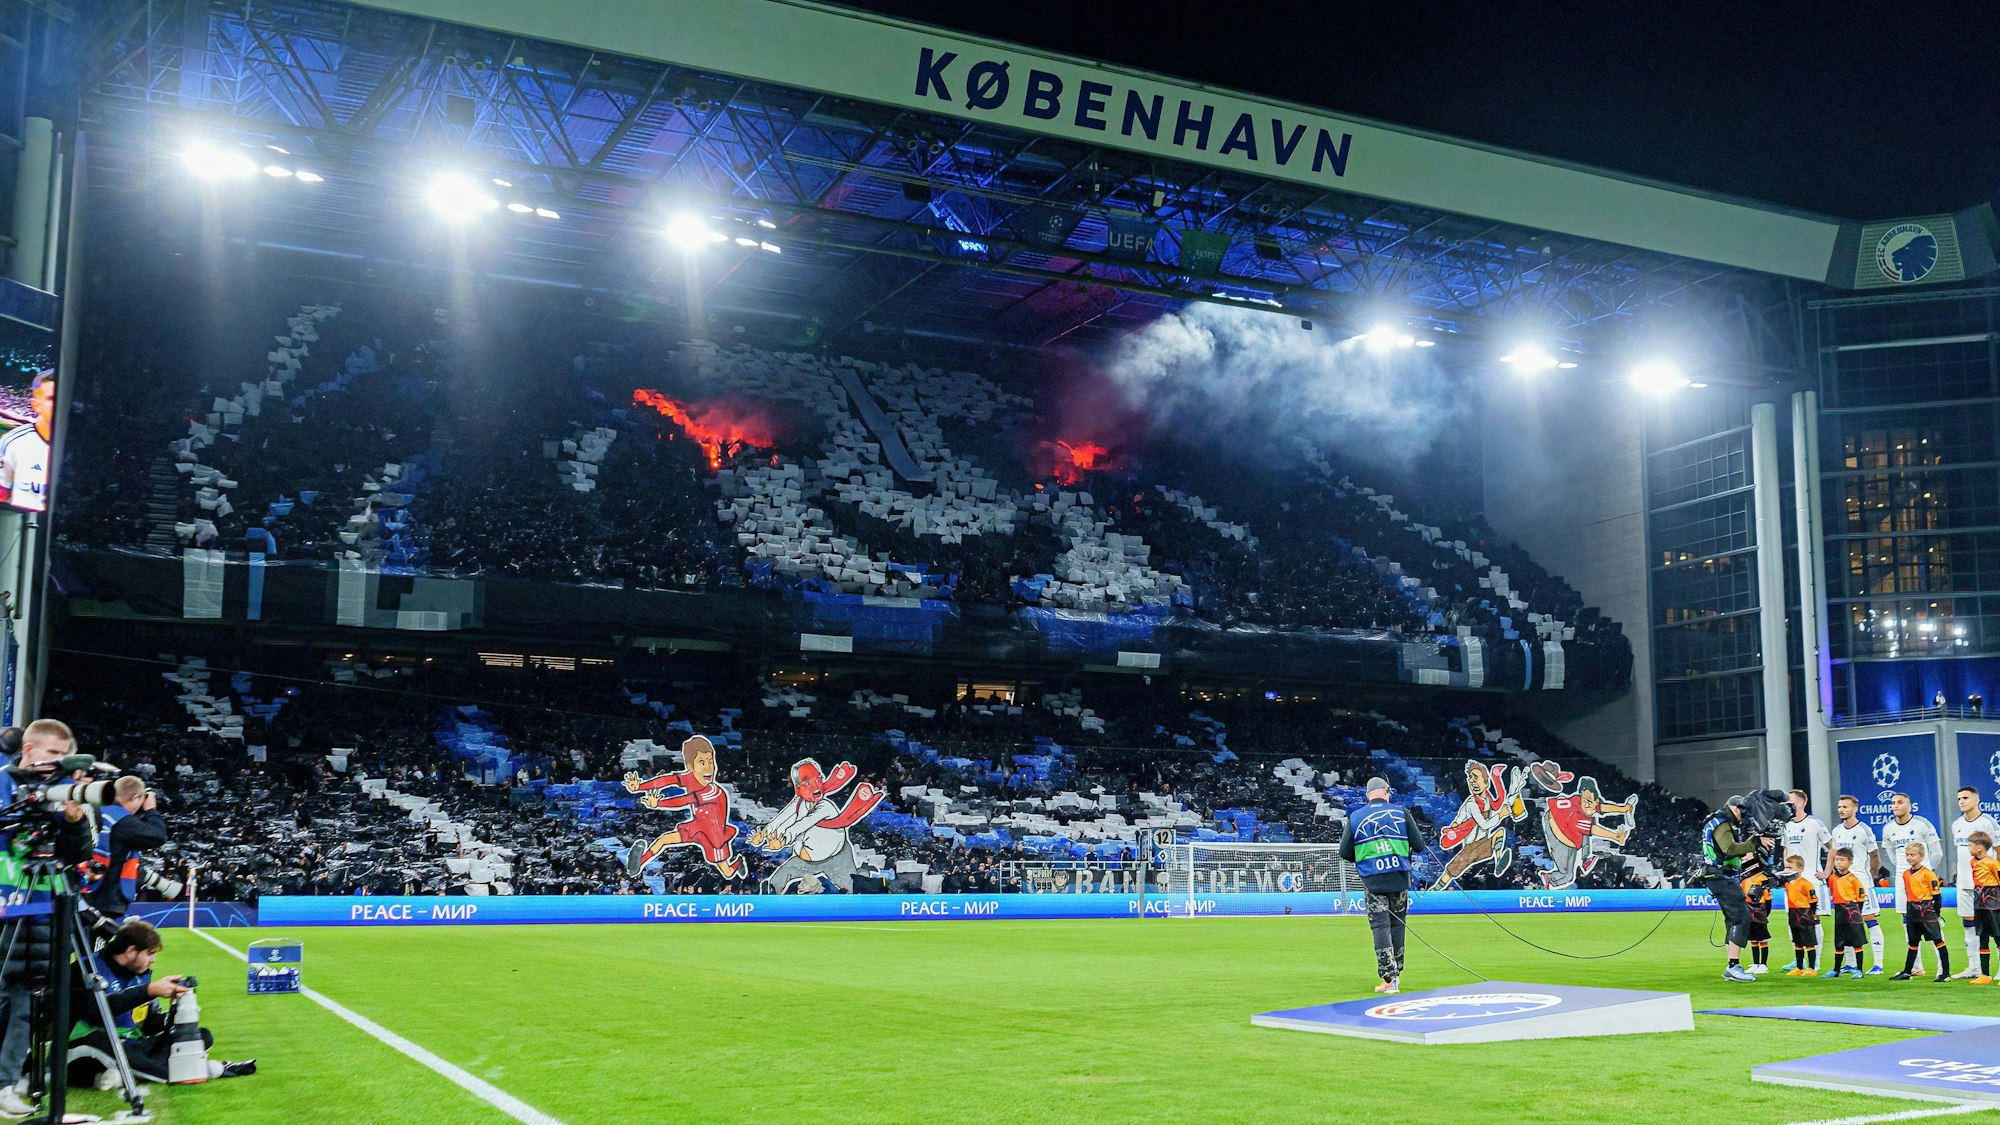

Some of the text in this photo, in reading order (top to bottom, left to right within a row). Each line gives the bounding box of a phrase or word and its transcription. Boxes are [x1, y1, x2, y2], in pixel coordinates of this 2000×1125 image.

[914, 47, 1353, 177] KØBENHAVN
[1860, 802, 1919, 815] CHAMPS
[1156, 831, 1169, 845] 12
[1375, 855, 1400, 871] 018
[901, 902, 949, 915] PEACE
[964, 901, 999, 915] МИР
[1333, 899, 1366, 911] PAC
[1519, 896, 1555, 908] PEACE
[1565, 895, 1592, 908] МИР
[351, 904, 413, 920] PEACE
[431, 904, 478, 920] МИР
[643, 903, 698, 918] PEACE
[714, 903, 755, 917] МИР
